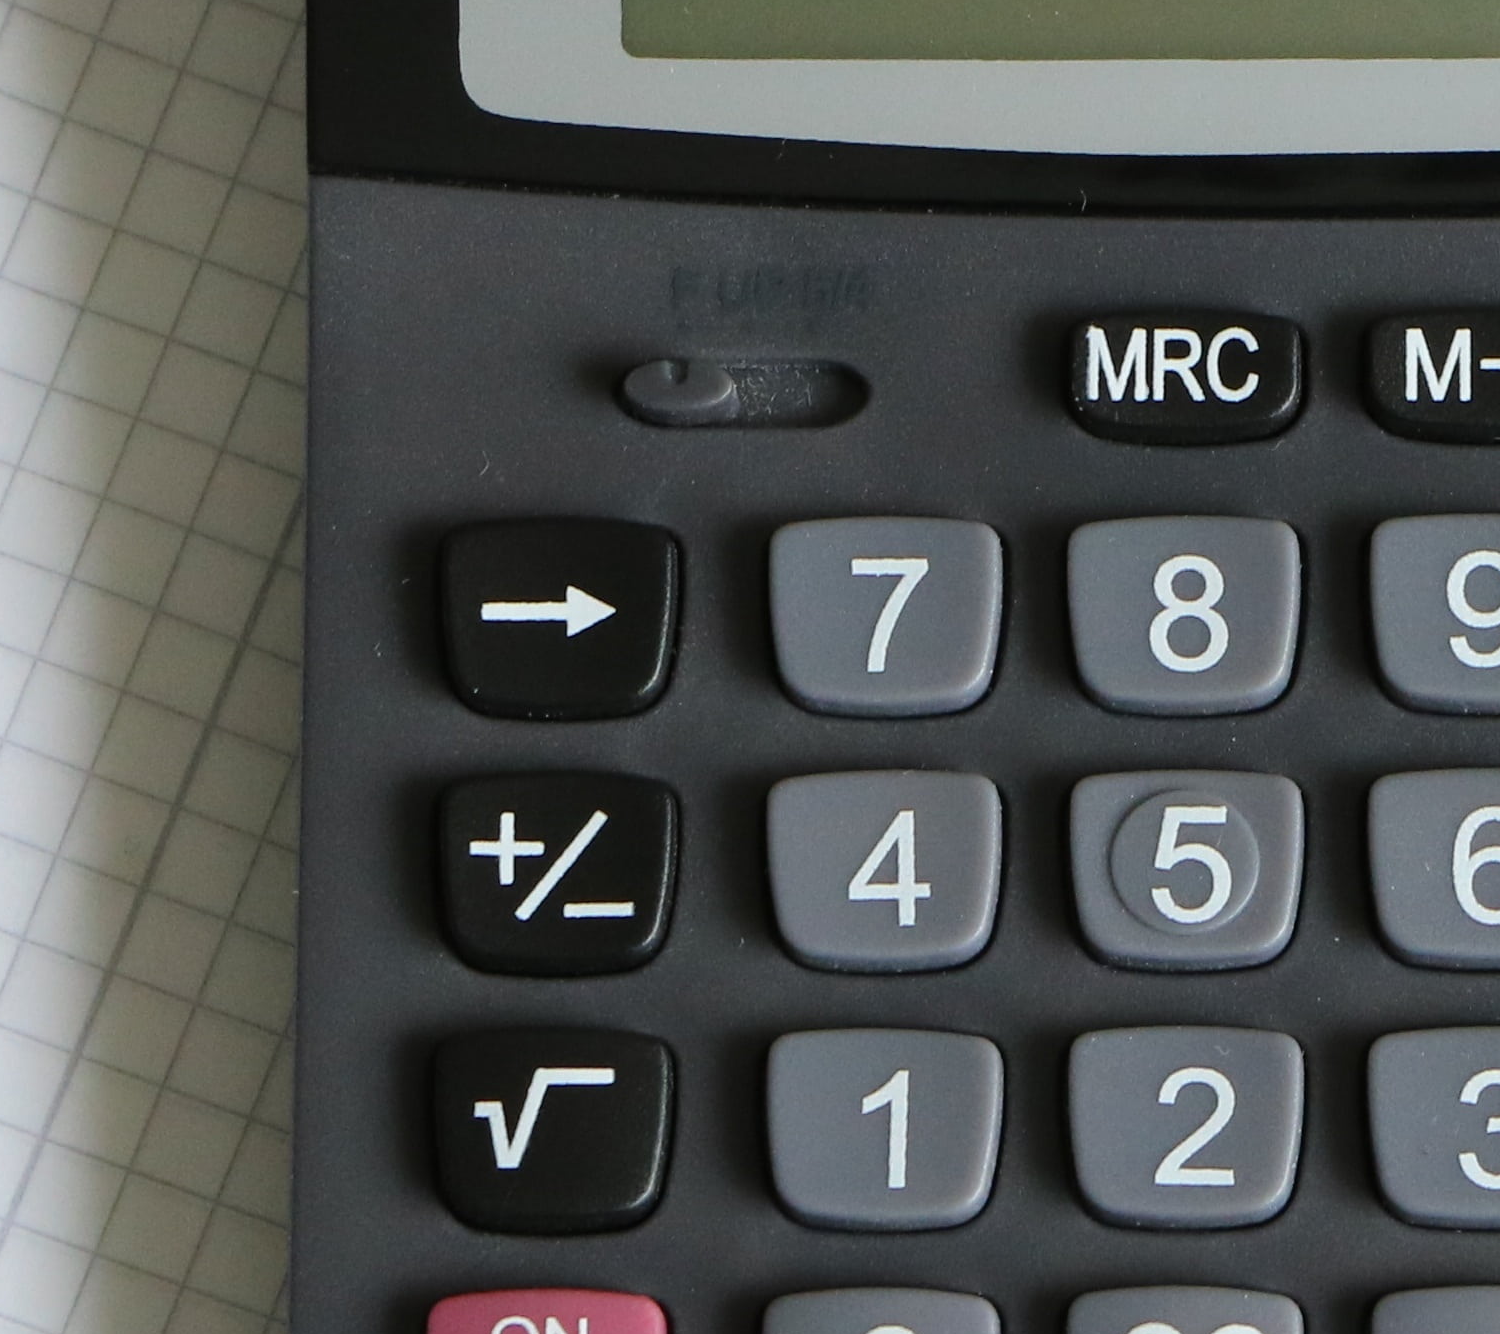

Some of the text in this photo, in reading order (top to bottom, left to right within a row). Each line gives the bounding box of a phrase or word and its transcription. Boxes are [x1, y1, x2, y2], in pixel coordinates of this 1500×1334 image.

[1085, 325, 1259, 402] MRC
[851, 558, 929, 673] 7
[1149, 555, 1229, 672] 8
[848, 810, 931, 927] 4
[1150, 805, 1233, 924] 5
[860, 1070, 910, 1189] 1
[1154, 1067, 1235, 1186] 2
